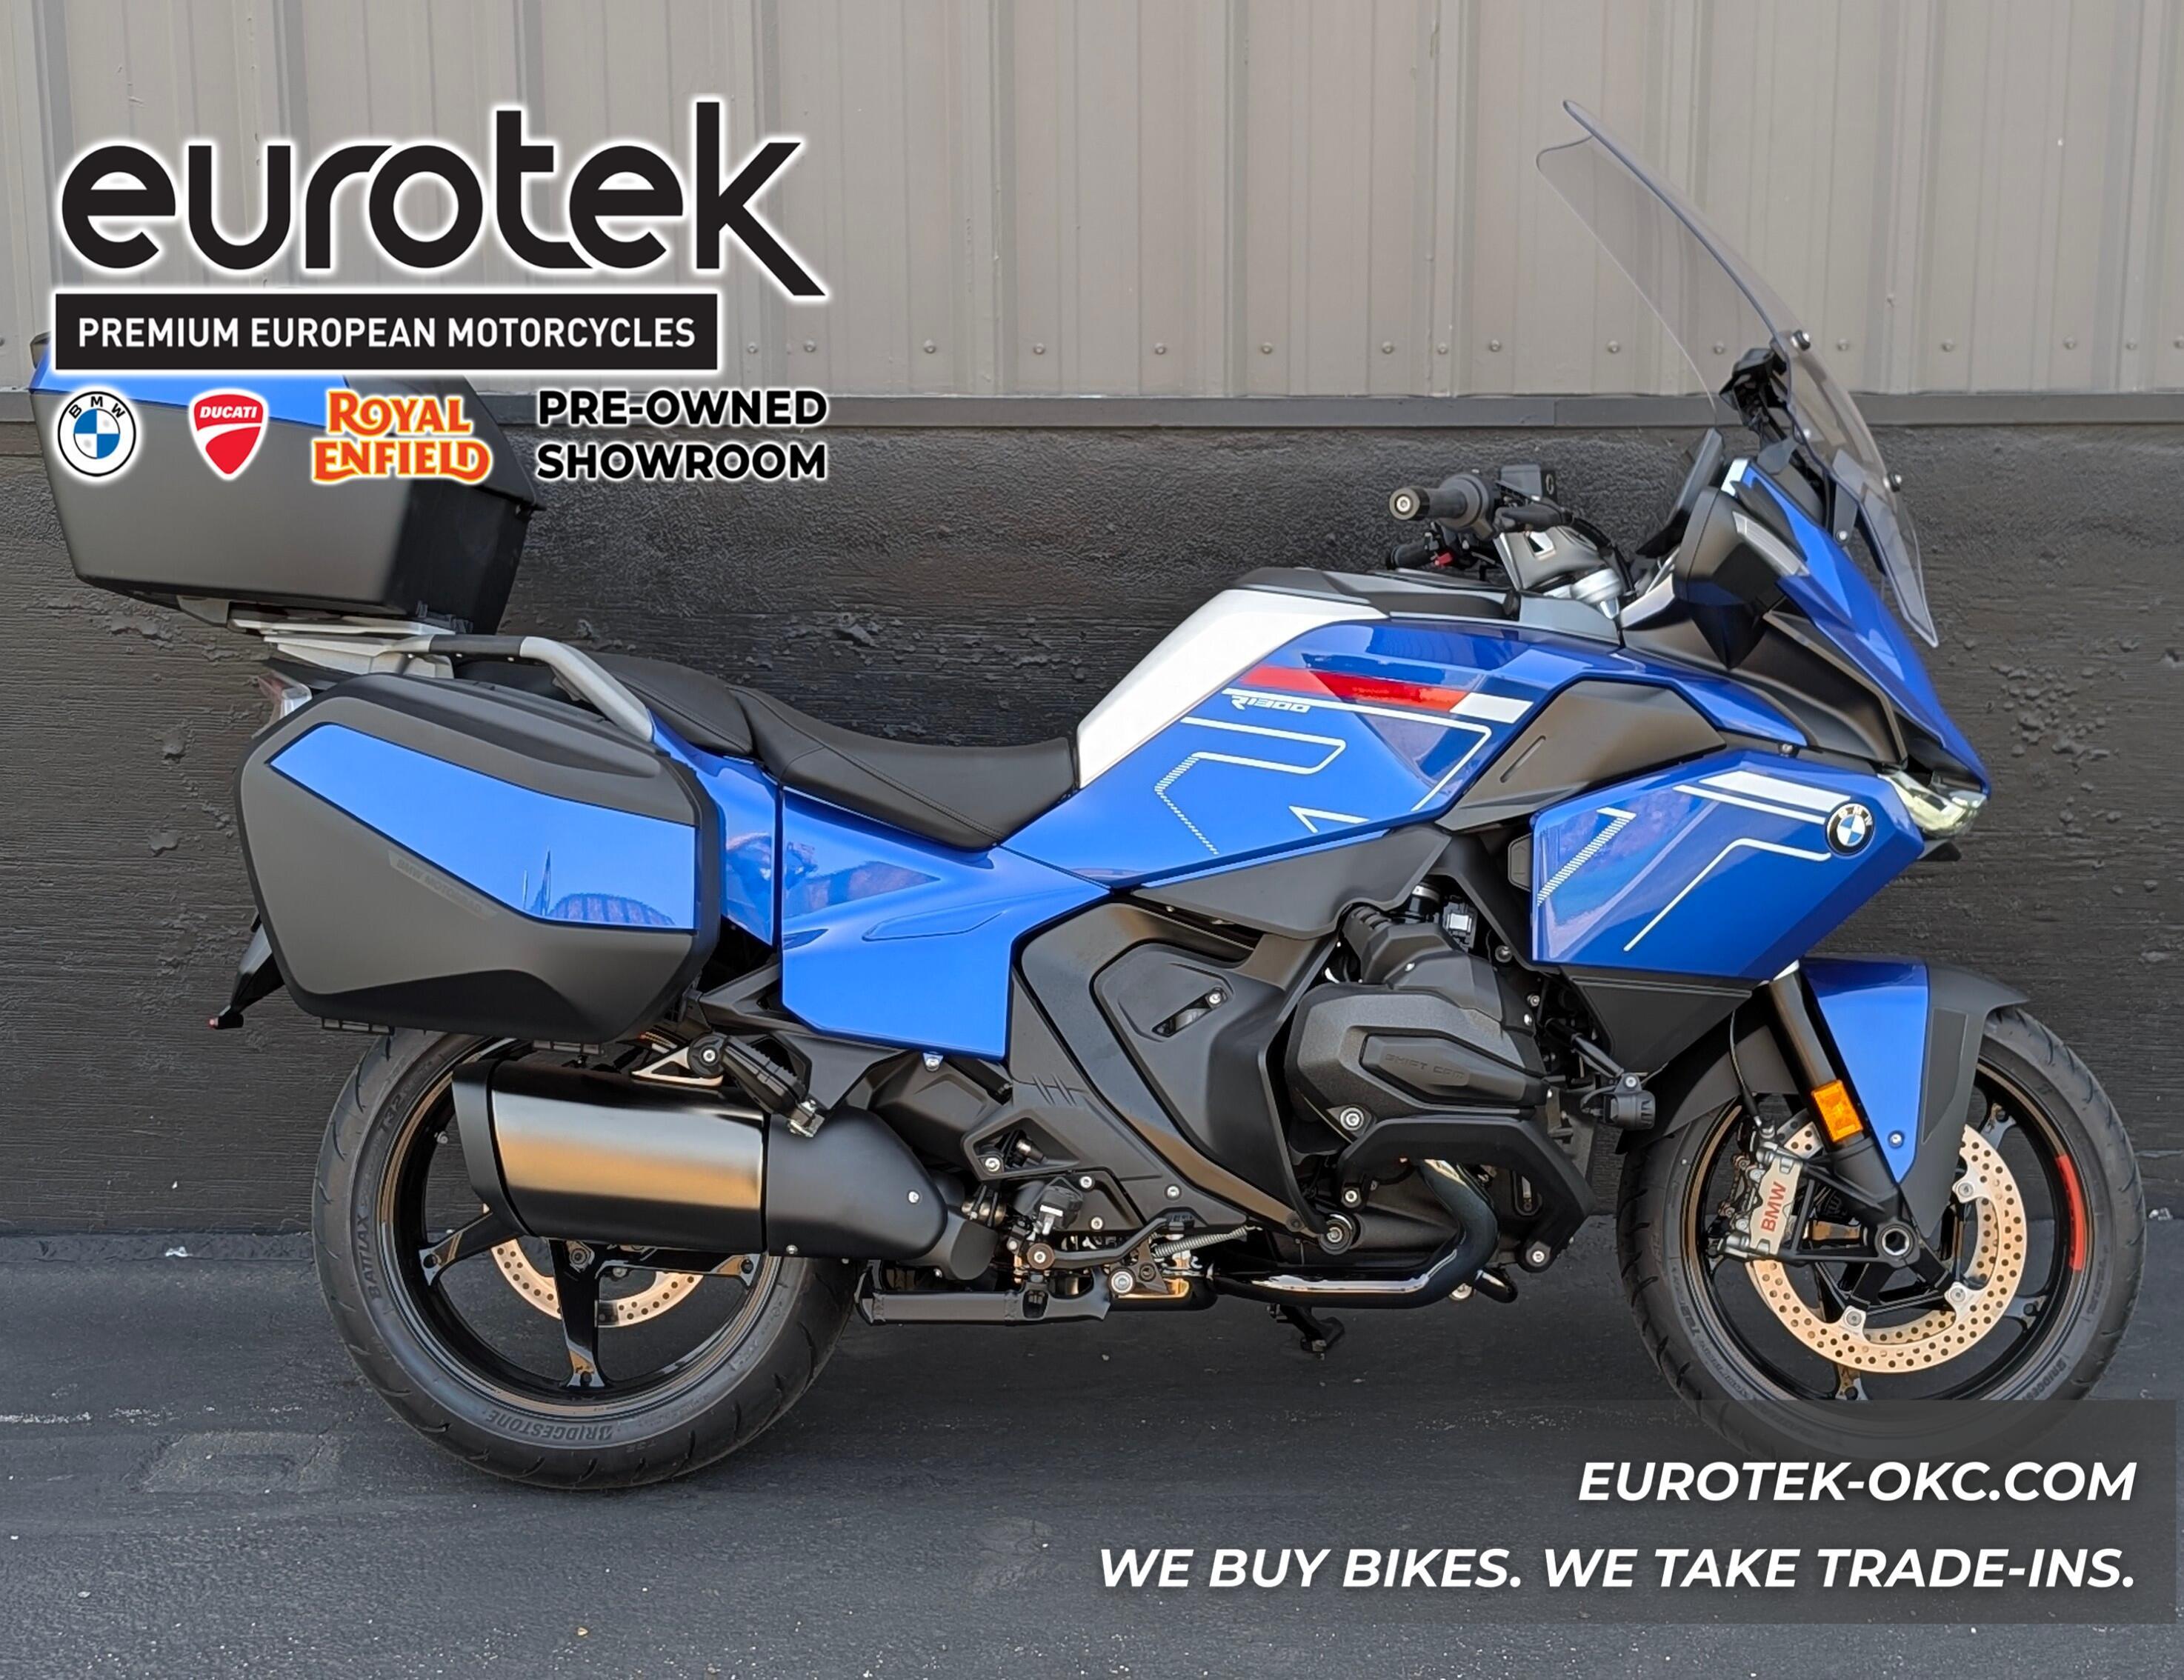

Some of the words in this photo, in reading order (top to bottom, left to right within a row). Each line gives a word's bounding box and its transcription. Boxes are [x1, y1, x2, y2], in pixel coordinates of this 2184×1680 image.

[1760, 1181, 1786, 1233] BMW
[356, 1213, 383, 1300] BATTLAX
[484, 1409, 613, 1441] BRIDGESTONE
